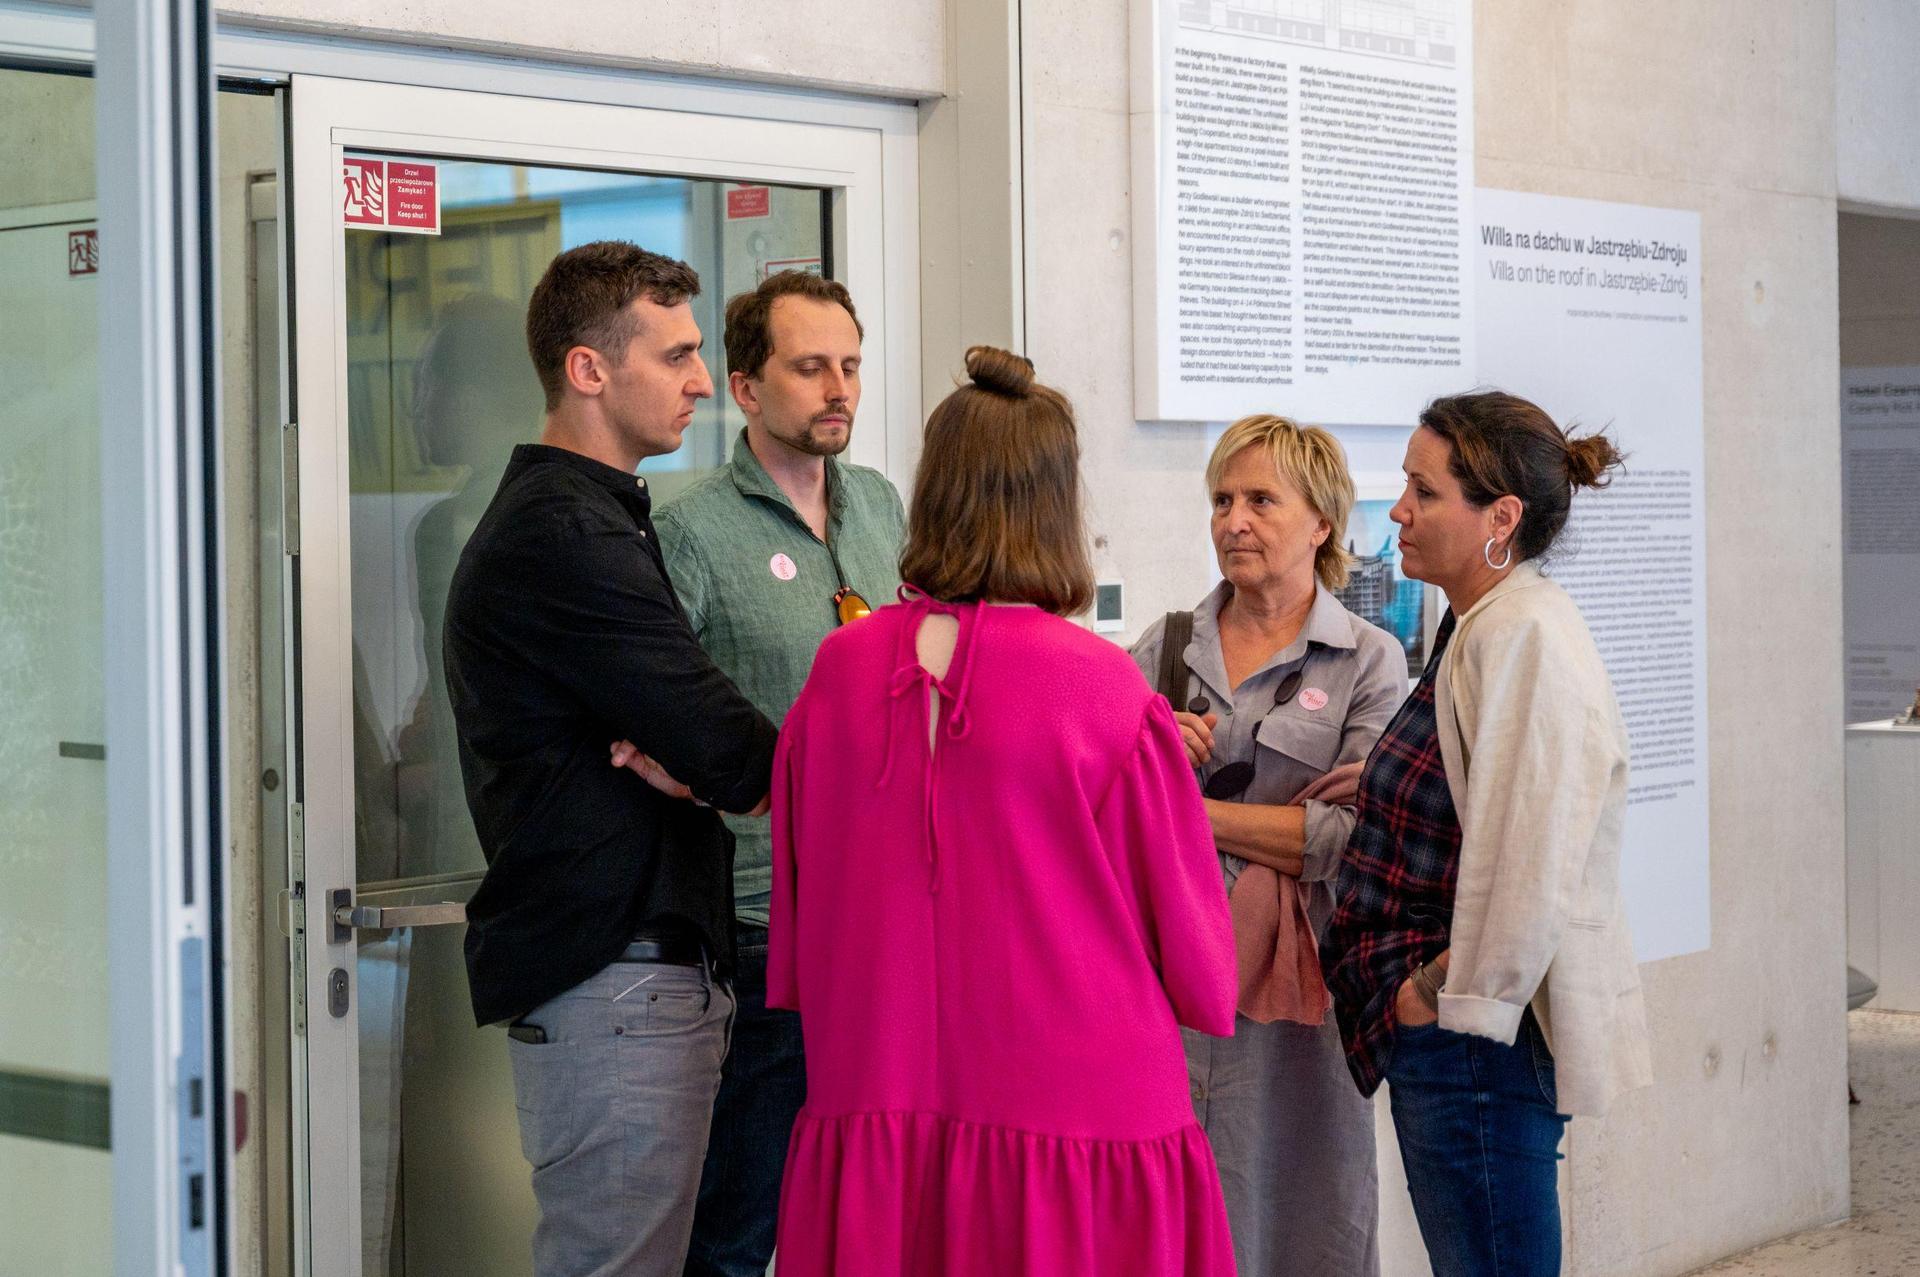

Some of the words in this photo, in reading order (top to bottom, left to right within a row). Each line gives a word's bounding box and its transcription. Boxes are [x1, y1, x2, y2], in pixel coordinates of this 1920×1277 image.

[1482, 225, 1512, 246] Willa
[1516, 233, 1530, 248] na
[1533, 231, 1571, 251] dachu
[1574, 239, 1585, 252] w
[1587, 236, 1687, 266] Jastrzębiu-Zdroju
[1489, 260, 1514, 280] Villa
[1518, 268, 1532, 282] on
[1536, 266, 1555, 284] the
[1560, 267, 1584, 286] roof
[1587, 269, 1597, 286] in
[1600, 269, 1687, 299] Jastrzębie-Zdrój
